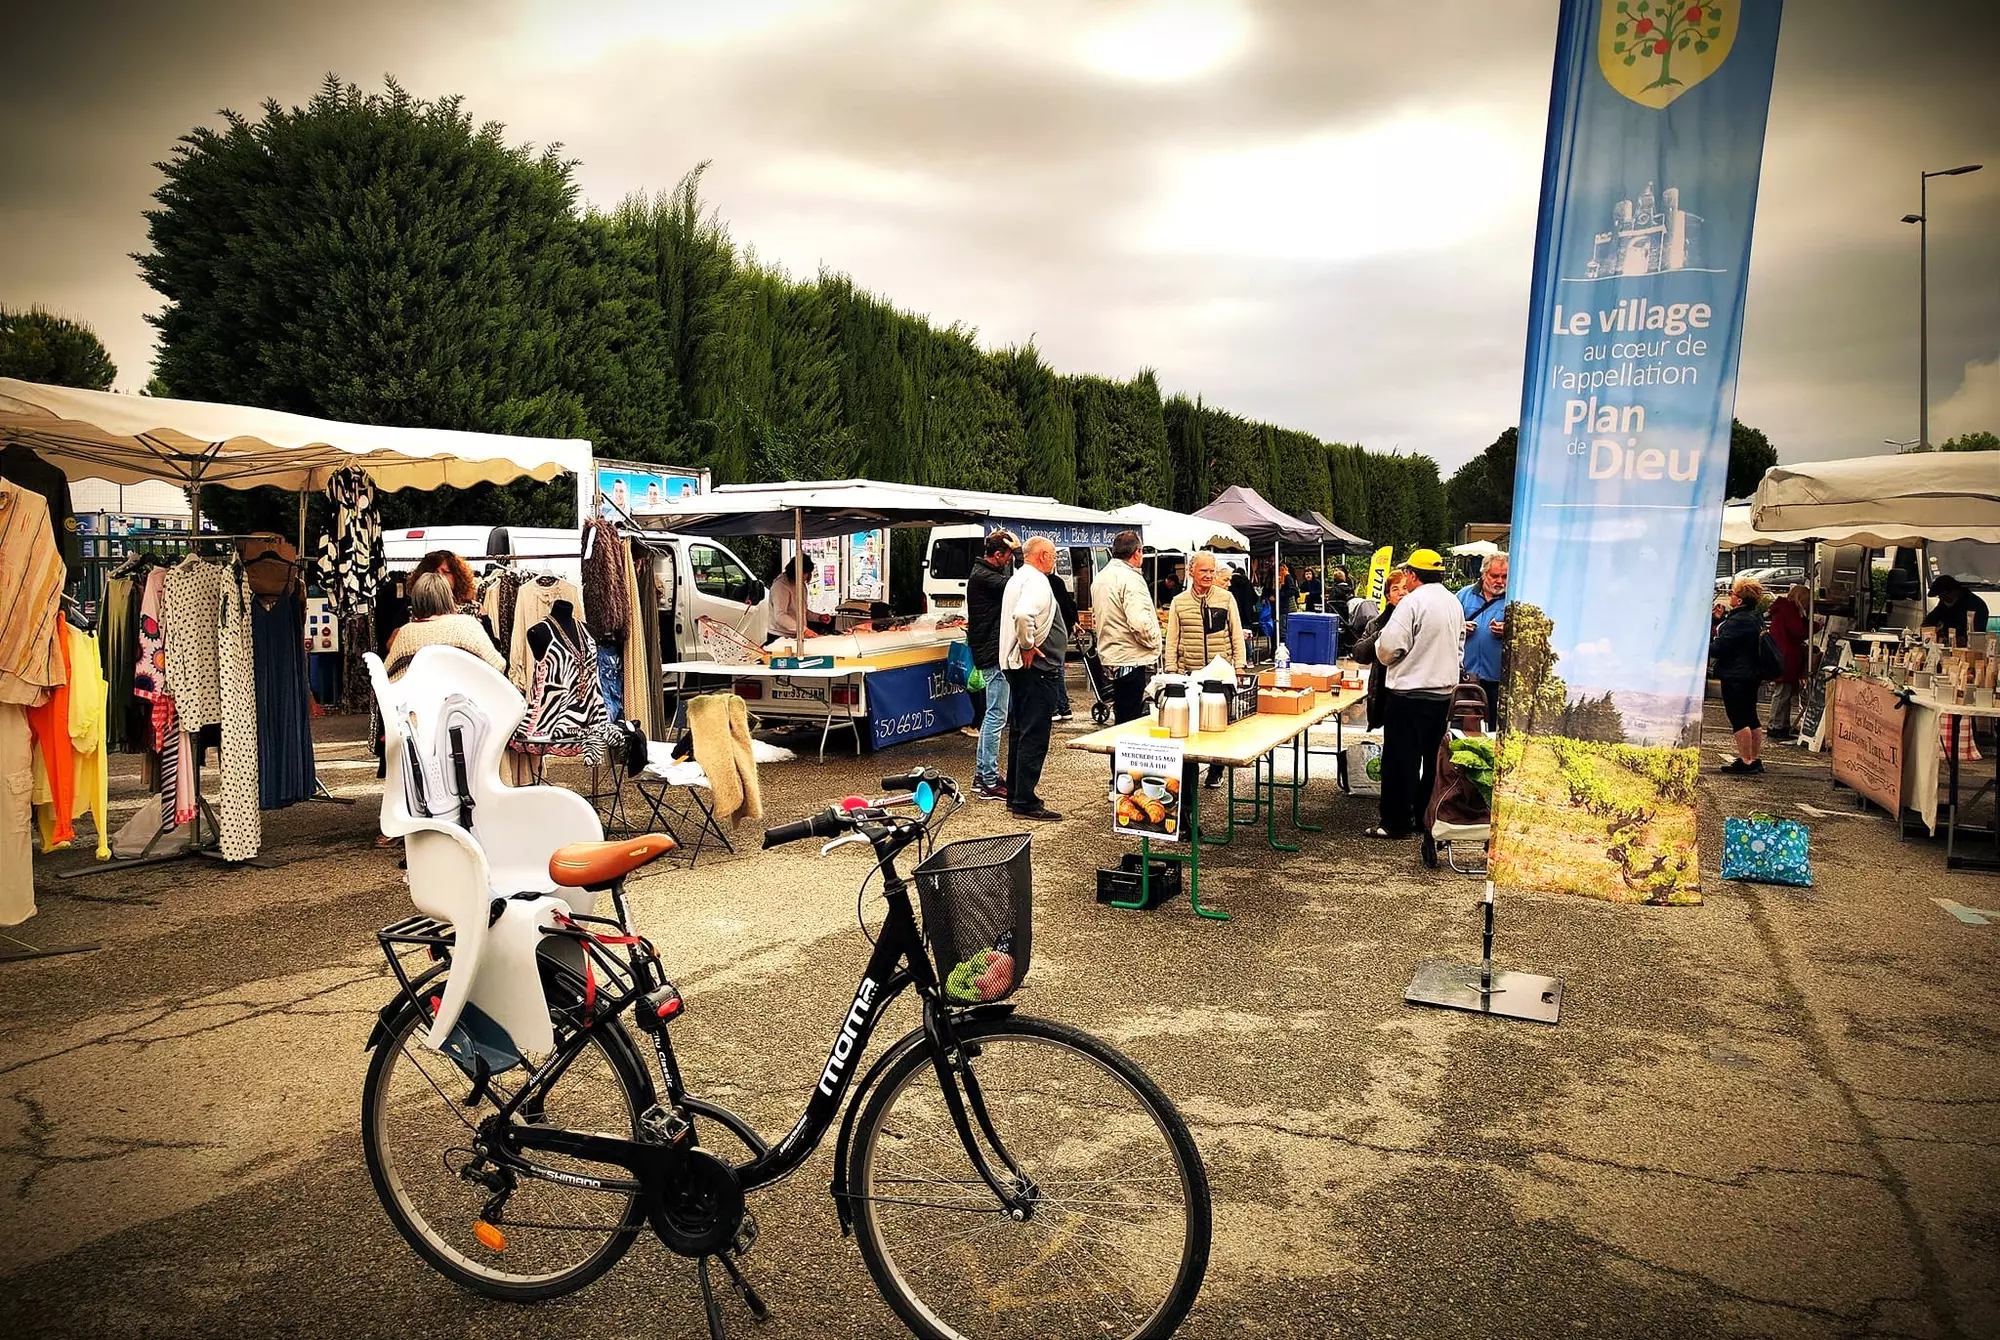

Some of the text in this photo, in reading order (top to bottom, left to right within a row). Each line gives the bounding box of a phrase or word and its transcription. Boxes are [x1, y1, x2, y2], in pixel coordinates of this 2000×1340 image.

[1553, 297, 1712, 337] Le village
[1583, 333, 1708, 362] au cœur de
[1552, 361, 1698, 395] l'appellation
[1563, 396, 1646, 435] Plan
[1566, 437, 1701, 482] de Dieu
[818, 977, 876, 1097] moma
[546, 1170, 601, 1188] SHIMANO
